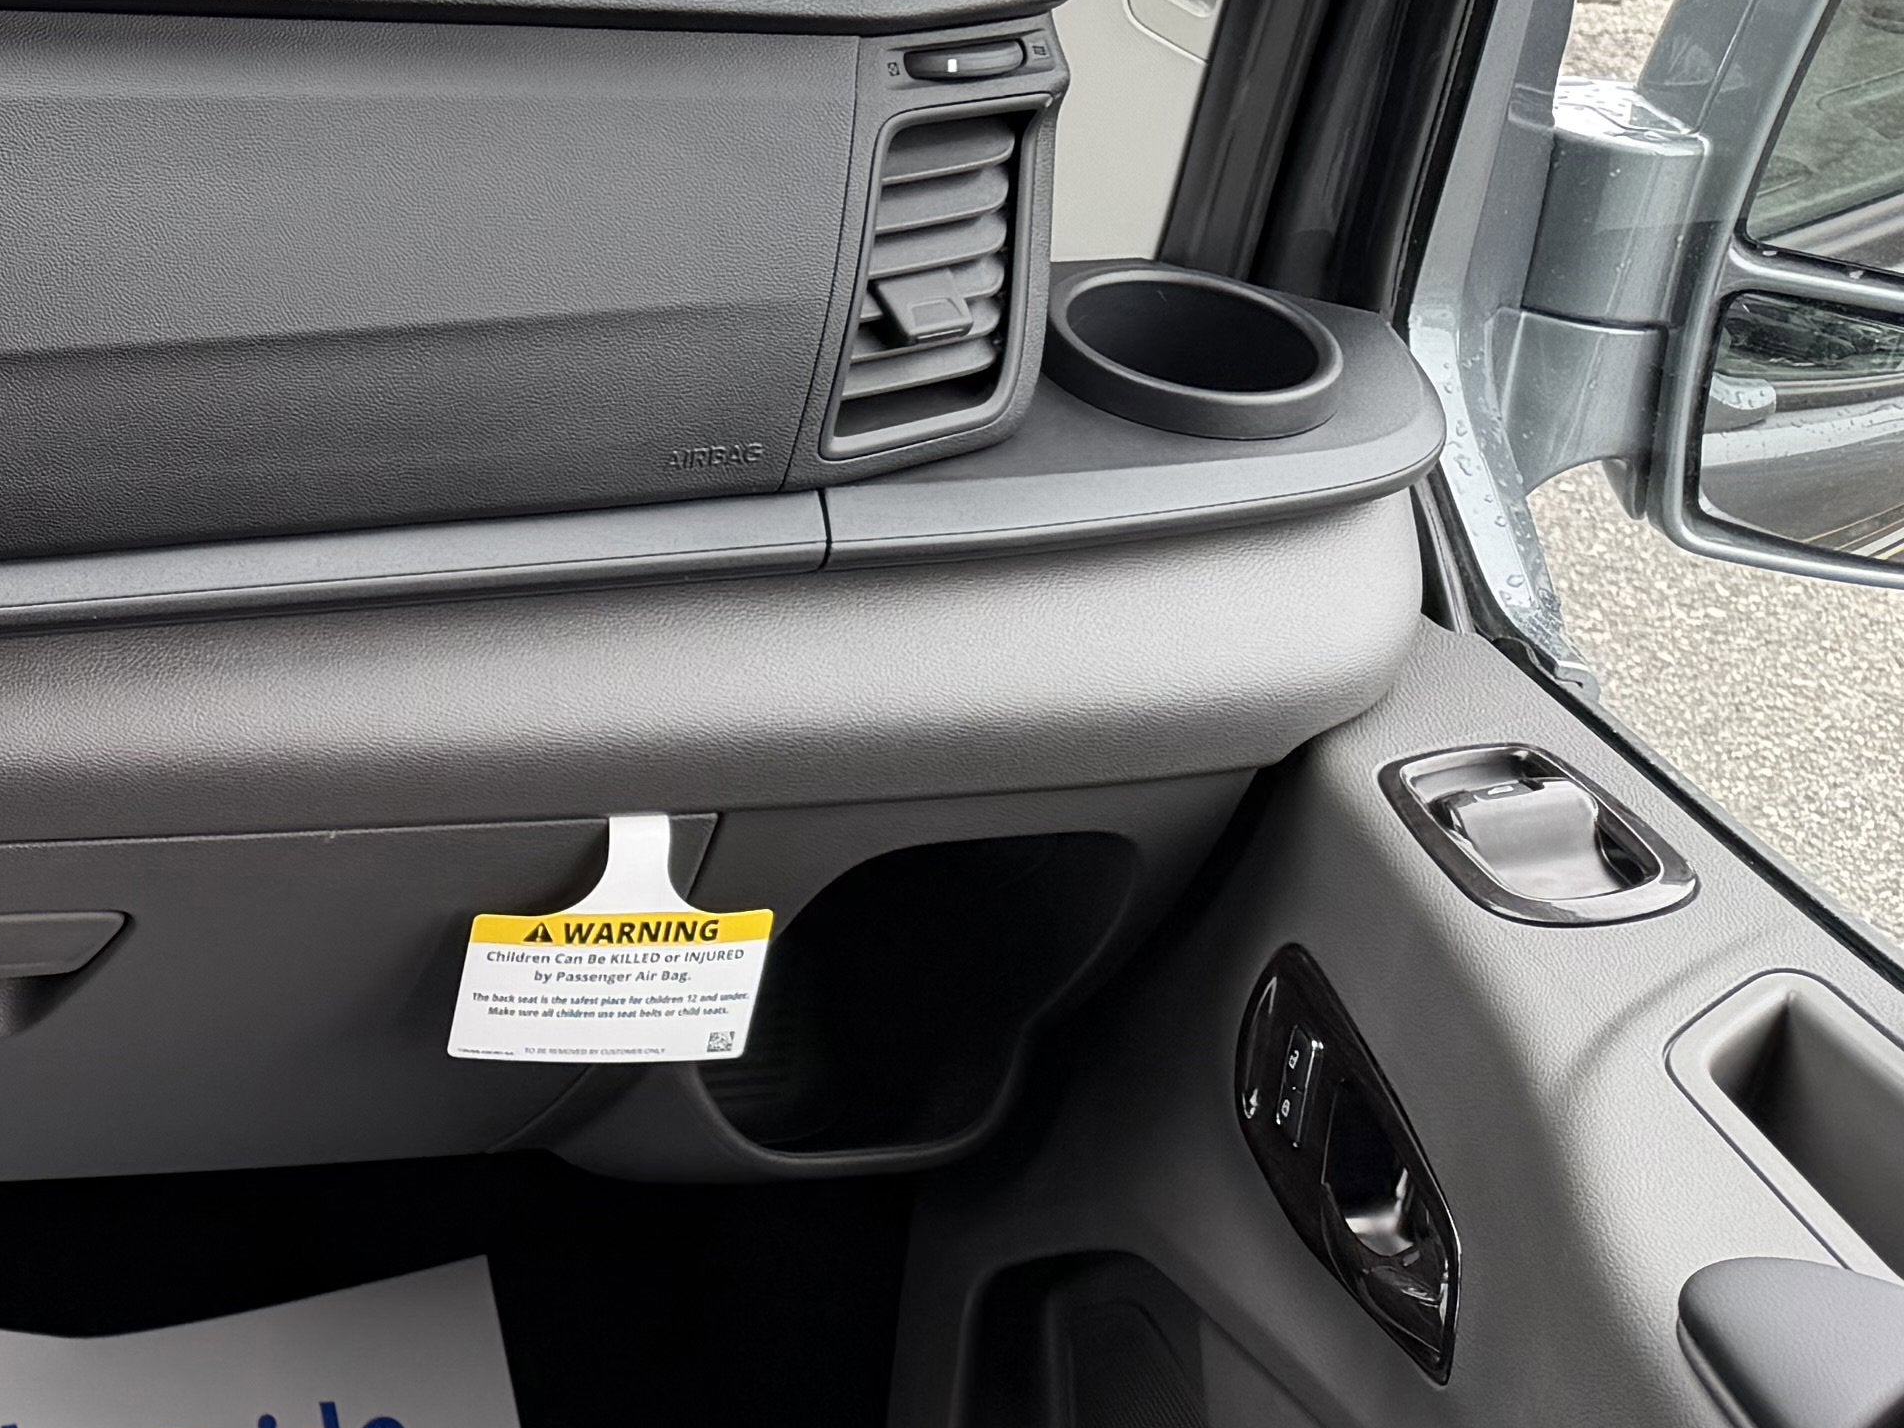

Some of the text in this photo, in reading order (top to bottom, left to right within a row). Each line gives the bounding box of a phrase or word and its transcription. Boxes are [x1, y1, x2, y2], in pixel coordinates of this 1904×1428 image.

[664, 441, 764, 471] AIRBAG
[563, 919, 720, 945] WARNING
[486, 949, 745, 964] Children Can Be KILLED or INJURED
[533, 970, 691, 984] by Passenger Air Bag.
